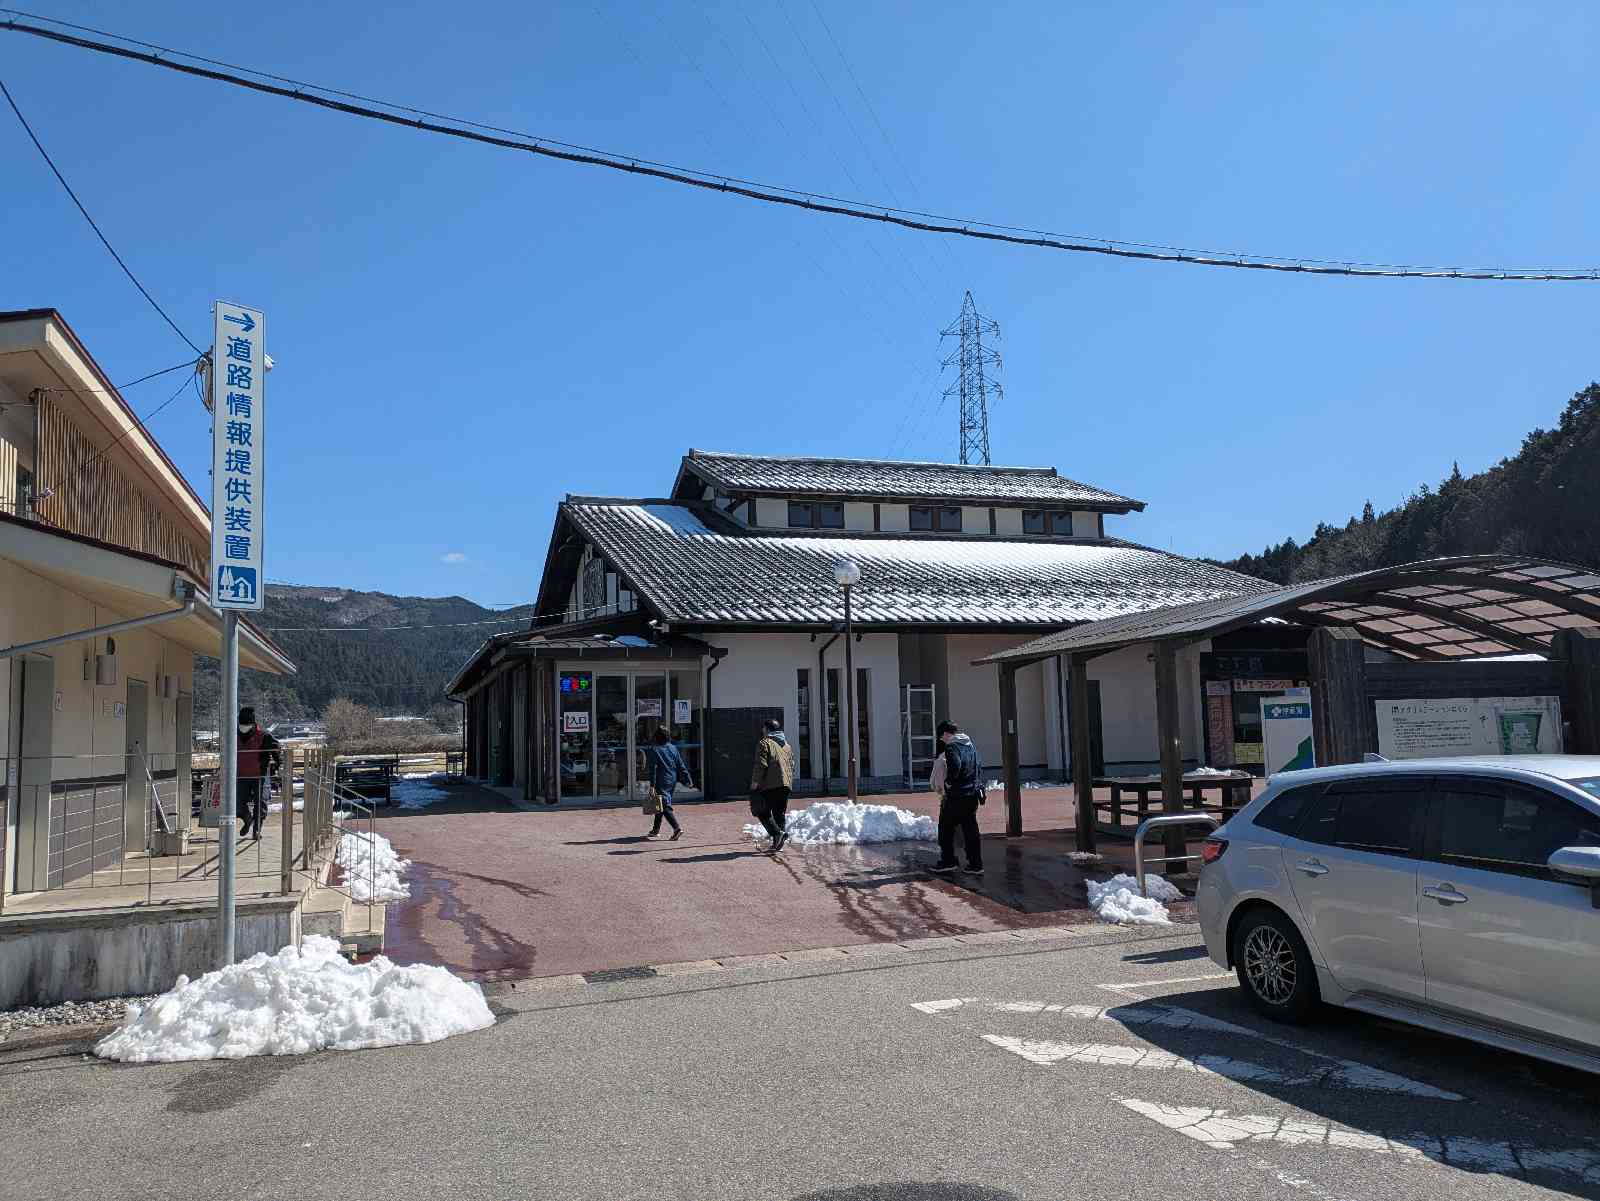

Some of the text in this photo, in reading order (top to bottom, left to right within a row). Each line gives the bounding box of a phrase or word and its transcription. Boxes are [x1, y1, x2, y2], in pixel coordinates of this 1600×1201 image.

[224, 336, 252, 561] 道路情報提供装置
